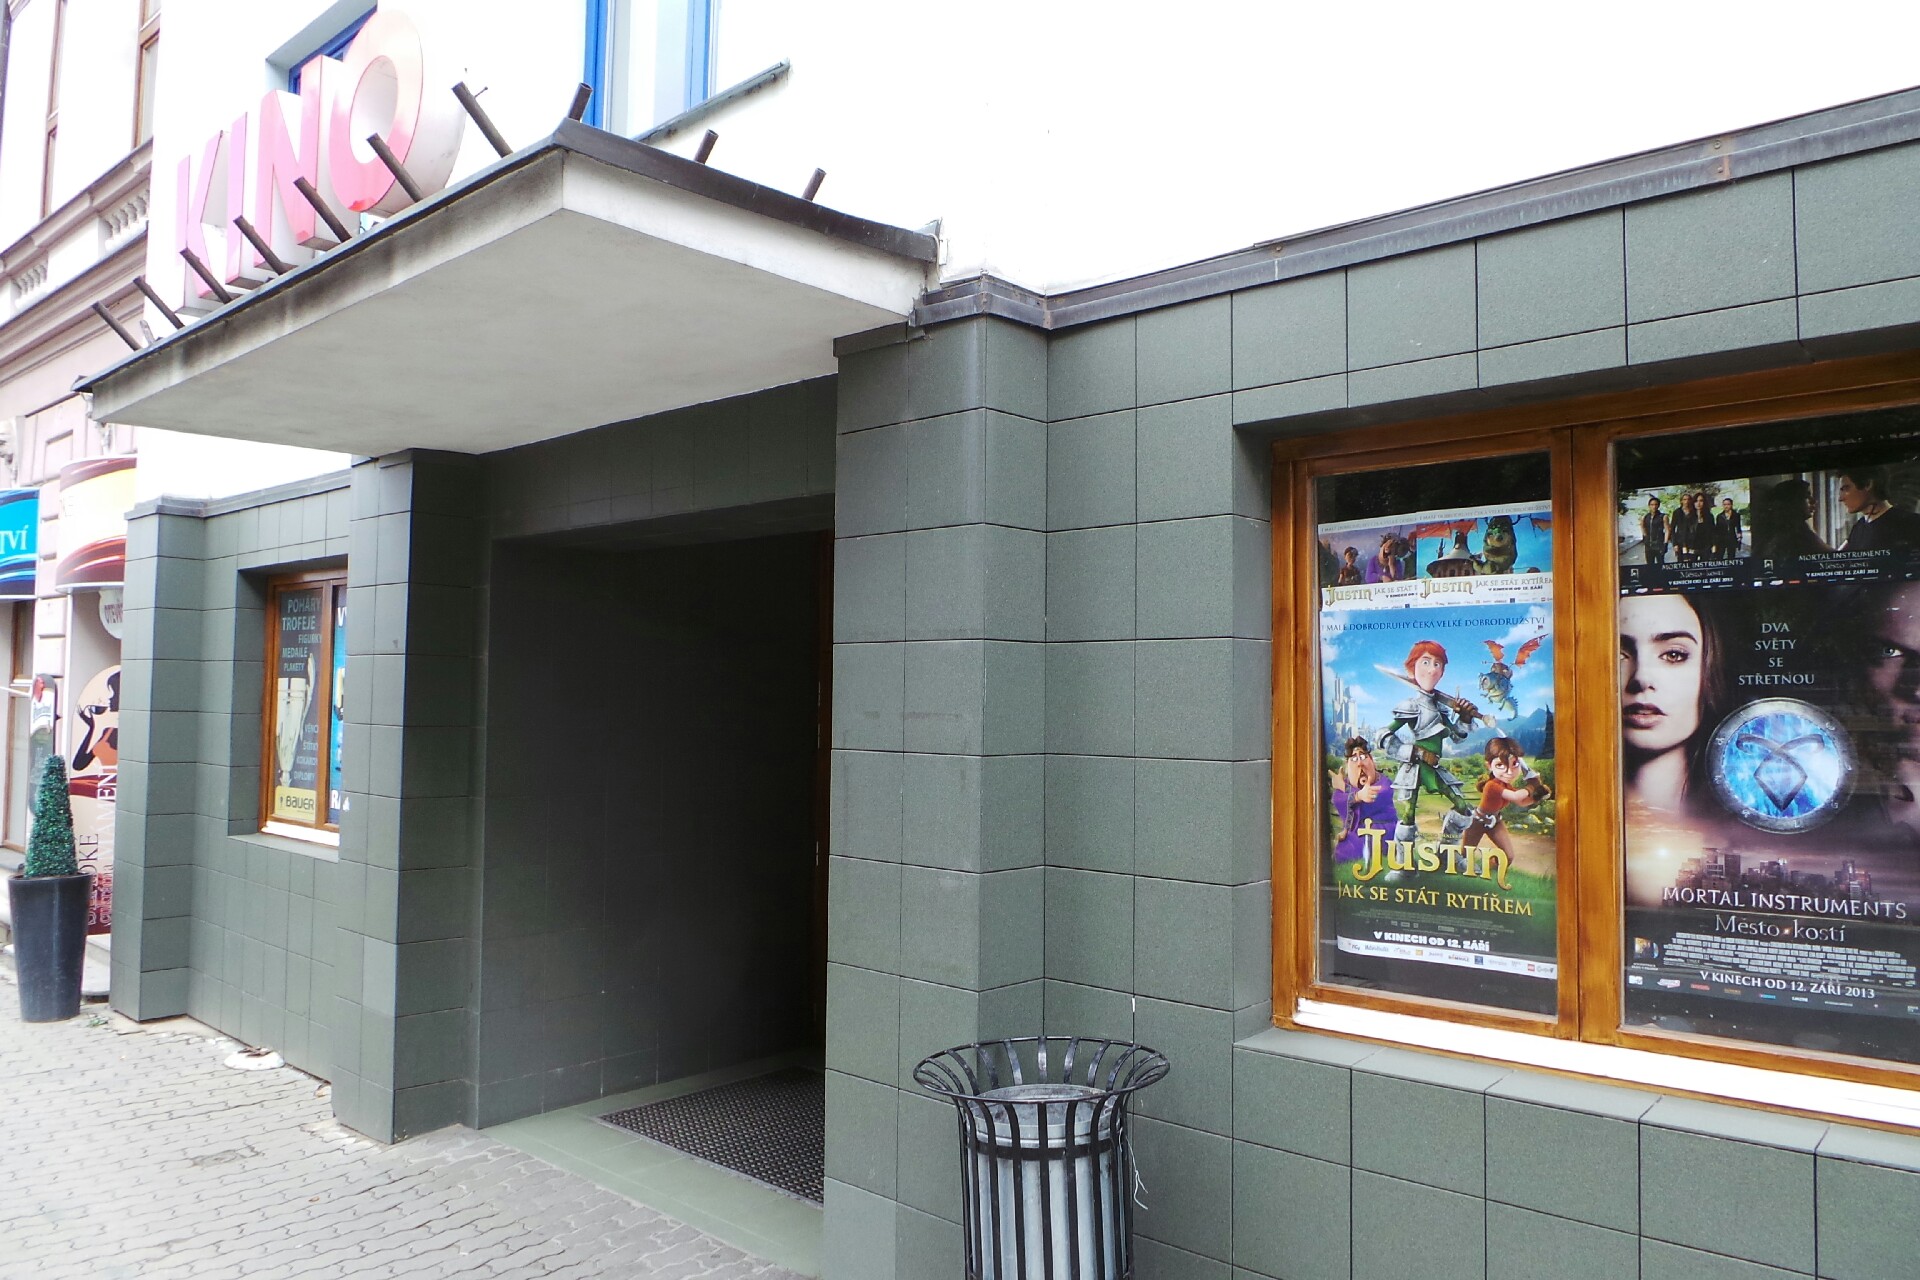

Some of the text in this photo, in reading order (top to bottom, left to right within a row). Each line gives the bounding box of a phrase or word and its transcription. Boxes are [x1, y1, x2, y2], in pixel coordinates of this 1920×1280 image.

[174, 9, 430, 307] KINO
[1832, 549, 1891, 559] INSTRUMENTS
[282, 615, 316, 631] TROFEJE
[1349, 621, 1410, 631] DOBRODRUHY
[1761, 622, 1791, 634] DVA
[1754, 637, 1798, 651] SVĚTY
[282, 647, 308, 659] MEDAILE
[1768, 657, 1784, 668] SE
[1738, 672, 1815, 686] STŘETNOU
[1338, 880, 1533, 917] JAK SE STÁT RYTÍŘEM
[1663, 887, 1907, 919] MORTAL INSTRUMENTS
[1715, 914, 1846, 942] Město kostí
[1373, 931, 1383, 940] V
[1384, 932, 1428, 945] KINECH
[1428, 937, 1446, 946] OD
[1700, 970, 1709, 981] V
[1712, 972, 1761, 988] KINECH
[1764, 979, 1787, 990] OD
[1790, 981, 1807, 992] 12.
[1810, 980, 1841, 996] ZÁŘÍ
[1844, 986, 1876, 999] 2013
